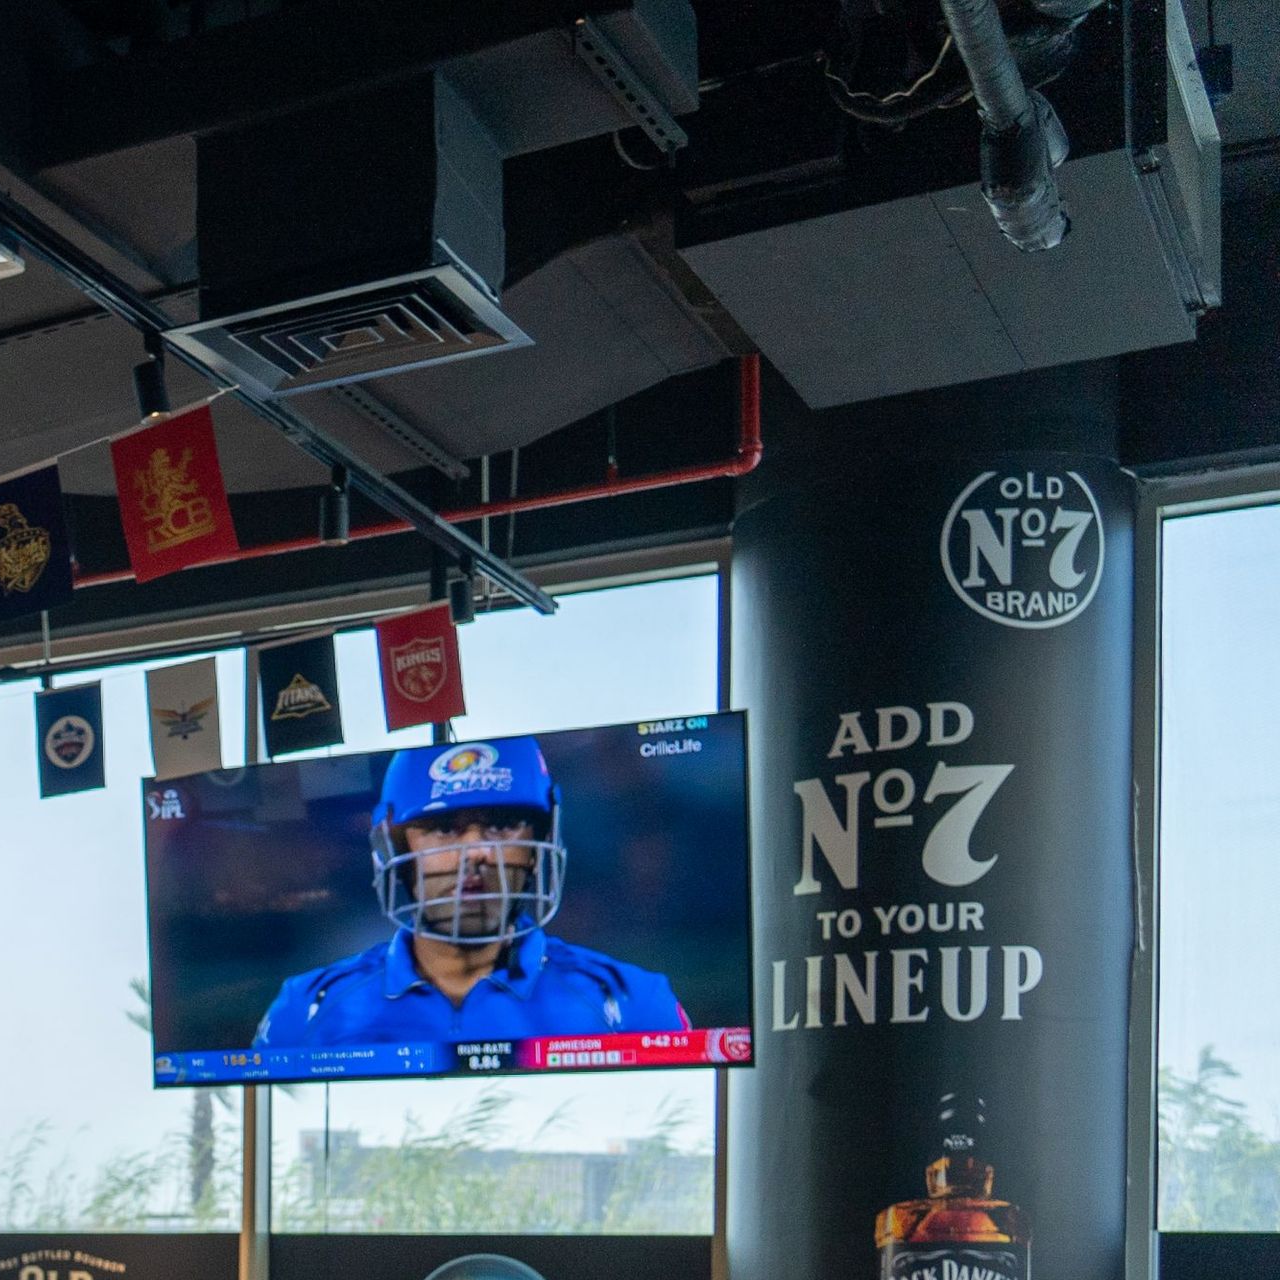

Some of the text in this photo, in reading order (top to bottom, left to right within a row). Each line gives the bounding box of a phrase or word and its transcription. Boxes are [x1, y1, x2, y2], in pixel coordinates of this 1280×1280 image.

[1000, 472, 1063, 500] OLD
[144, 499, 214, 538] RCB
[986, 590, 1077, 619] BRAND
[395, 648, 441, 671] KINGS
[686, 716, 708, 730] ON
[827, 701, 974, 759] ADD
[430, 774, 512, 799] INDIANS
[817, 901, 985, 940] TO YOUR
[771, 944, 1044, 1032] LINEUP
[21, 1249, 71, 1264] BOTTLED
[73, 1251, 127, 1274] BOURBON
